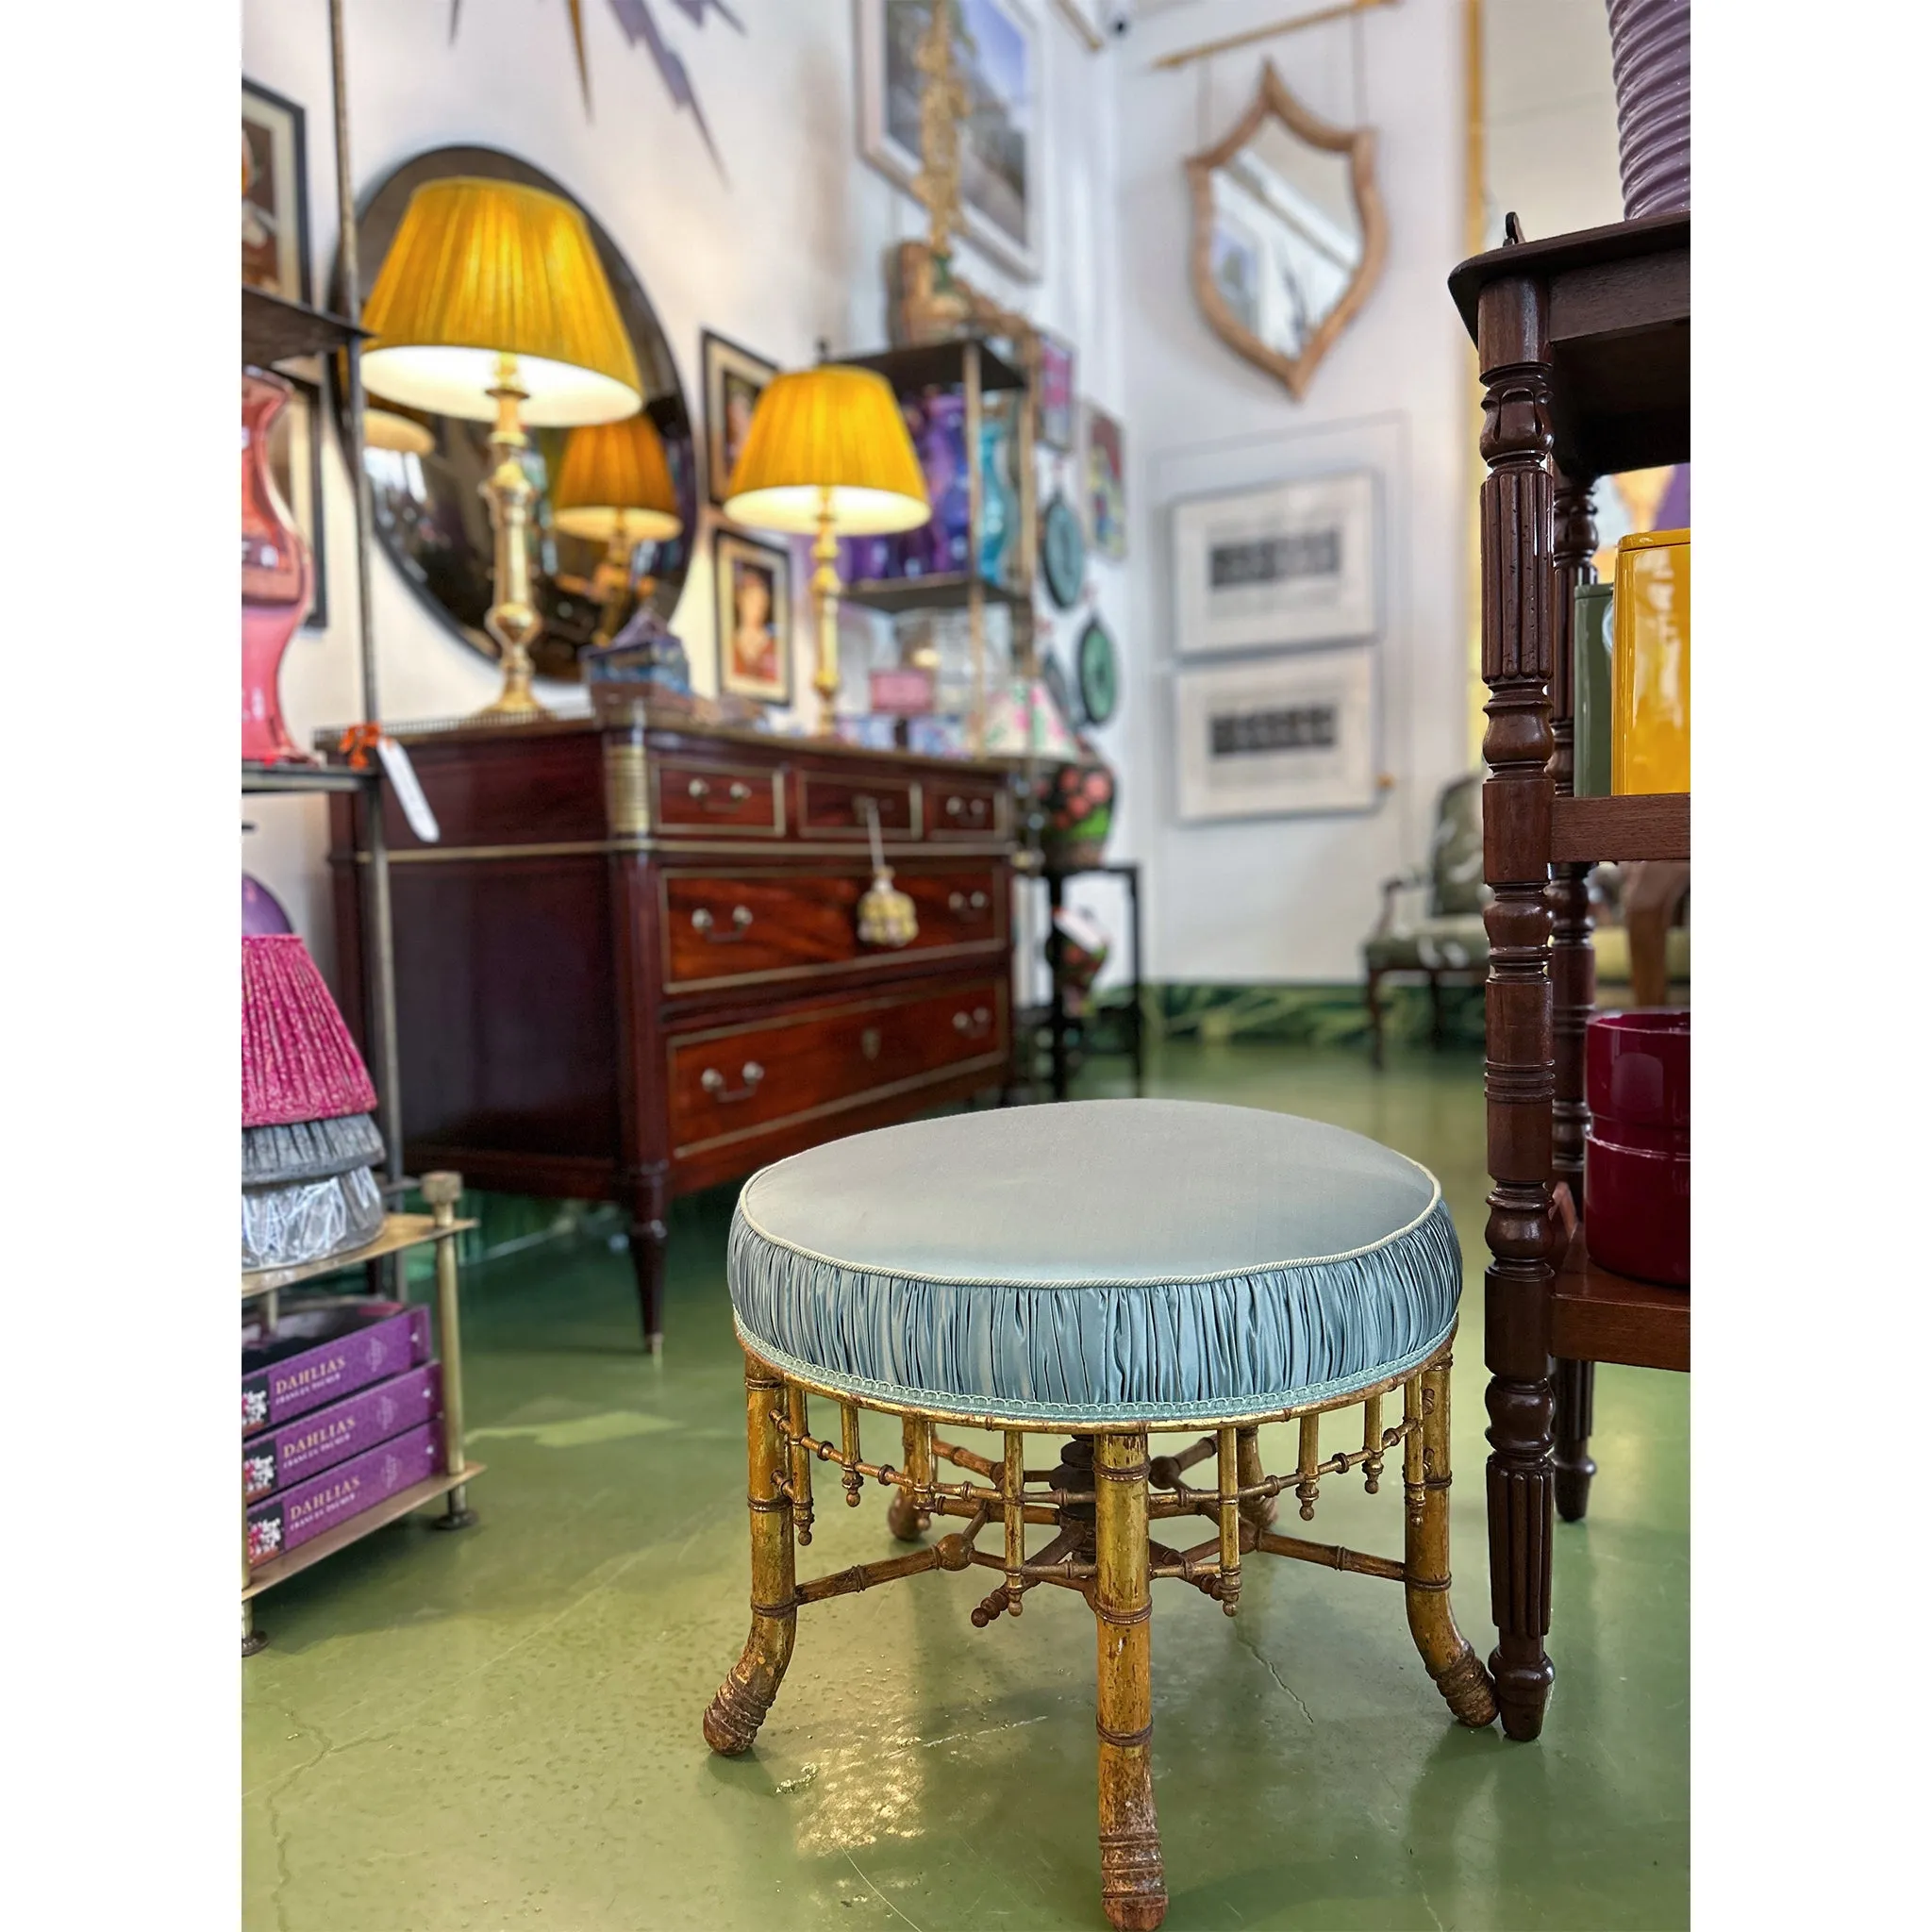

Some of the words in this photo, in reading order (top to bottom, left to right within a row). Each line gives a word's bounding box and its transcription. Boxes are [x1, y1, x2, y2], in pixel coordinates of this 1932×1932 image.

[276, 1357, 345, 1395] DAHLIAS
[284, 1417, 356, 1458] DAHLIAS
[291, 1477, 360, 1520] DAHLIAS
